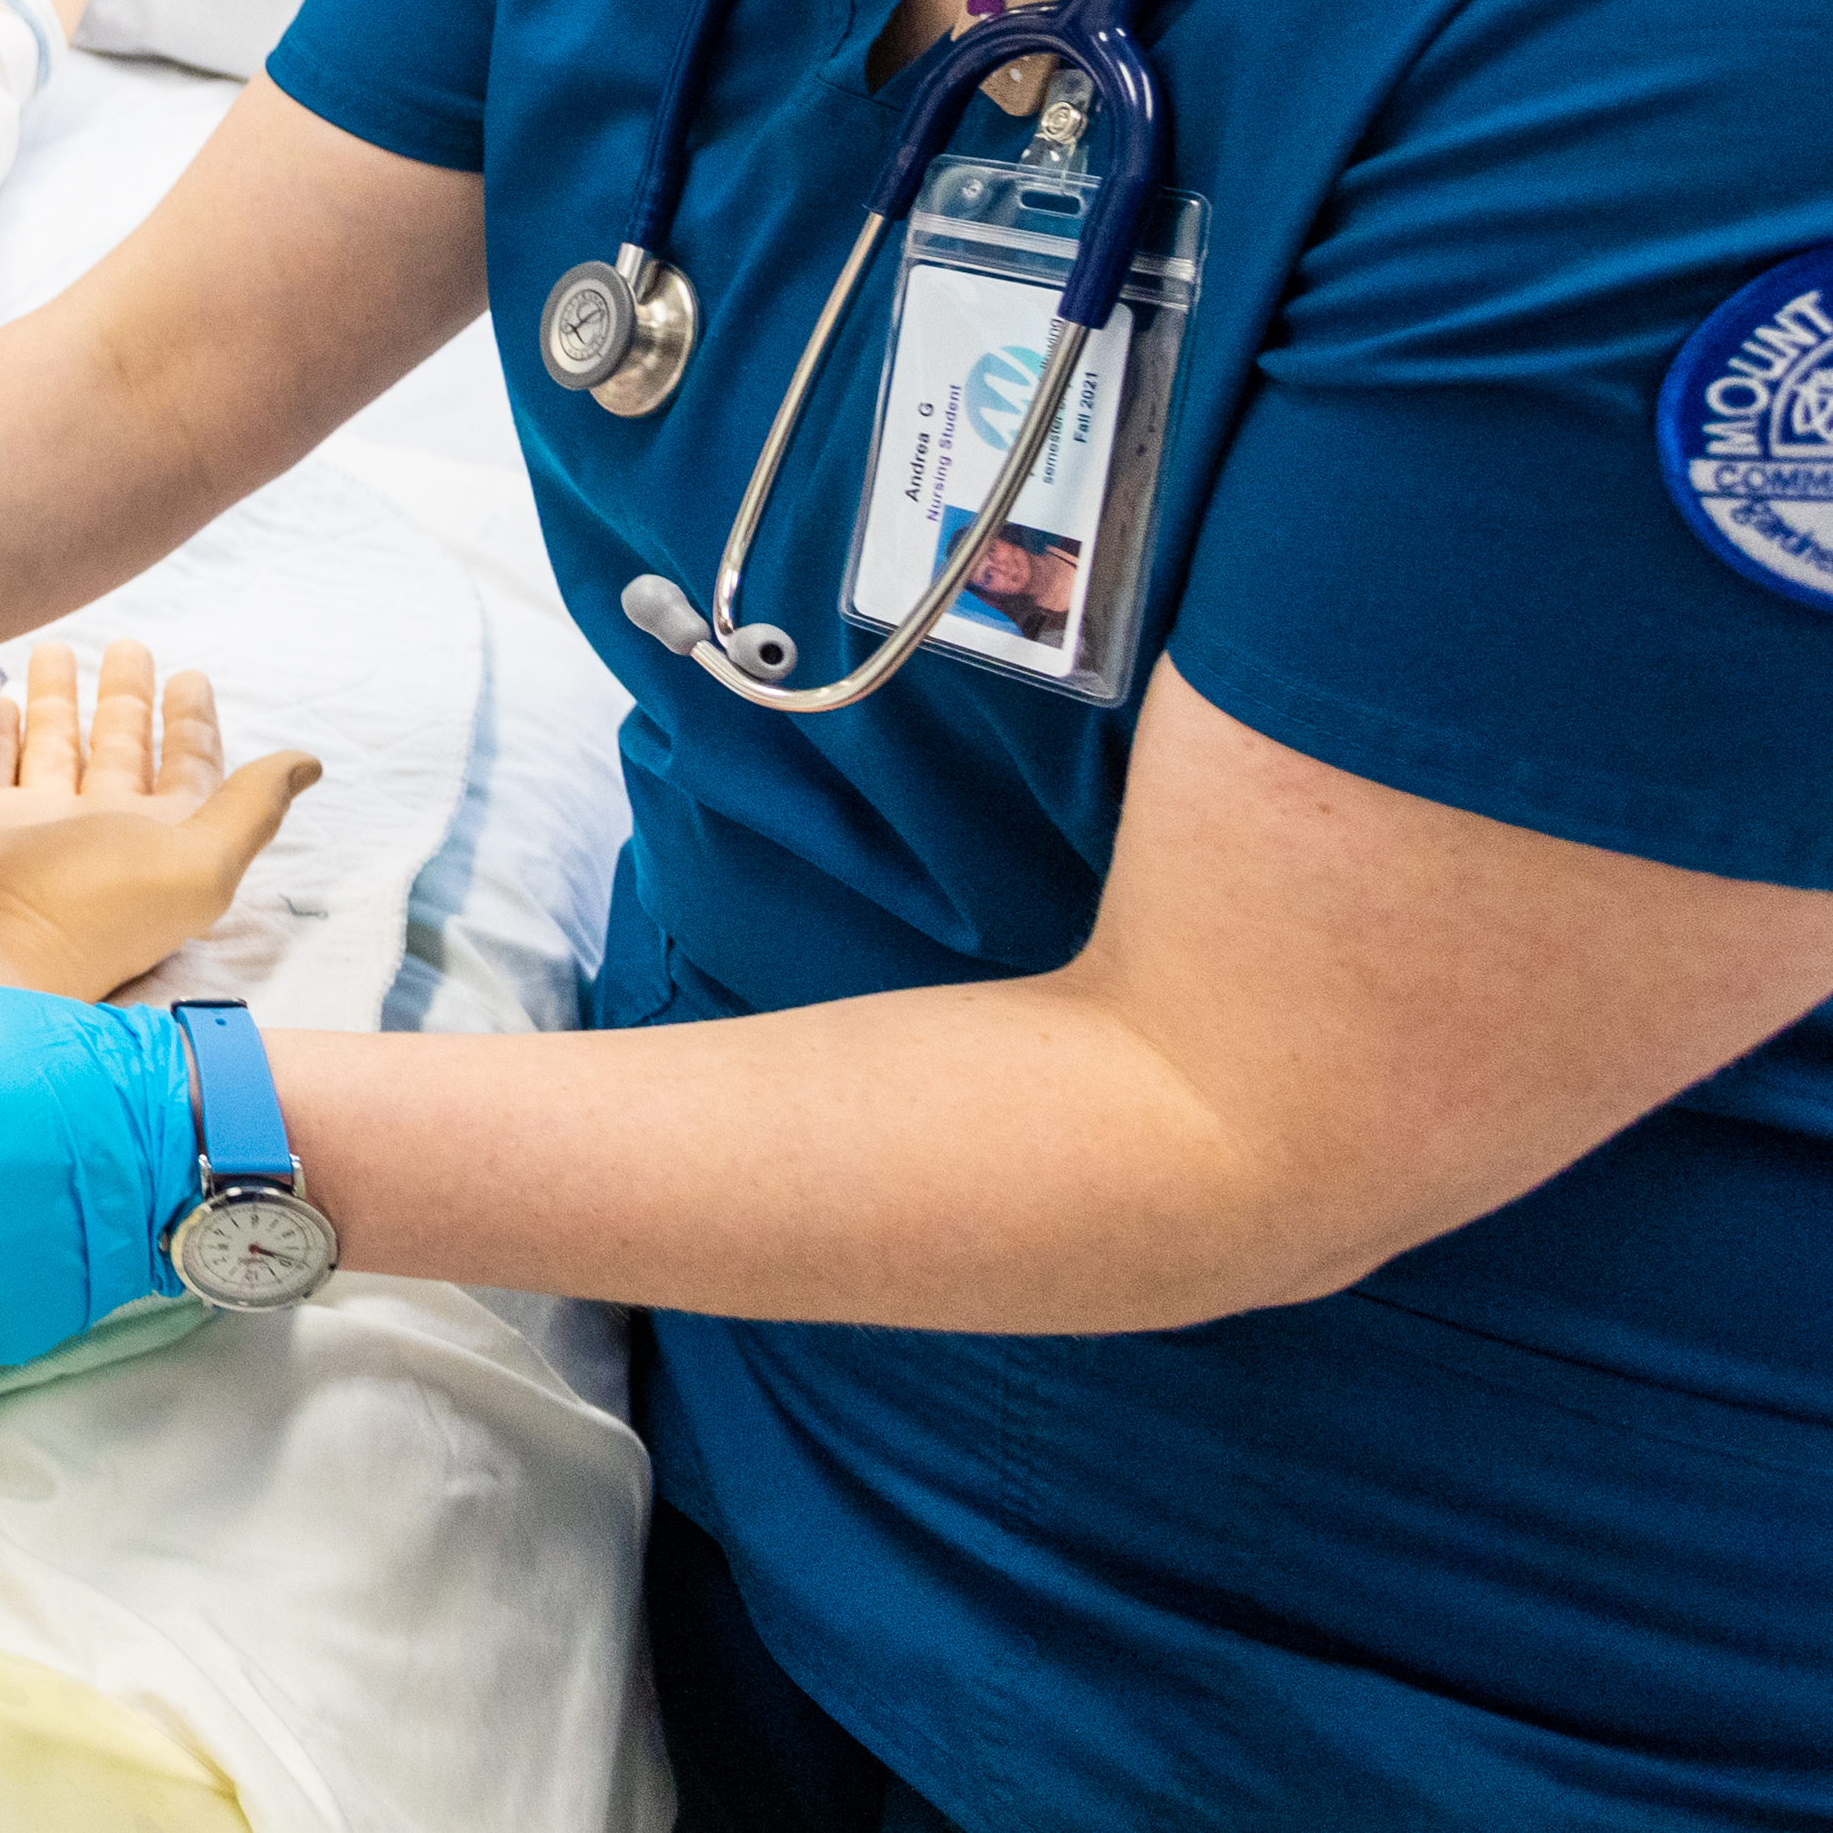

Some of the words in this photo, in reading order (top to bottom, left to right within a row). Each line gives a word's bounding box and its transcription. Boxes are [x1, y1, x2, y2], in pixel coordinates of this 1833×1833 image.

[1080, 371, 1098, 410] 2021
[1701, 289, 1833, 455] MOUNT
[939, 383, 962, 450] Student
[1073, 413, 1091, 444] Fall
[905, 432, 931, 503] Andrea
[918, 402, 934, 417] G
[926, 455, 953, 522] Nursing
